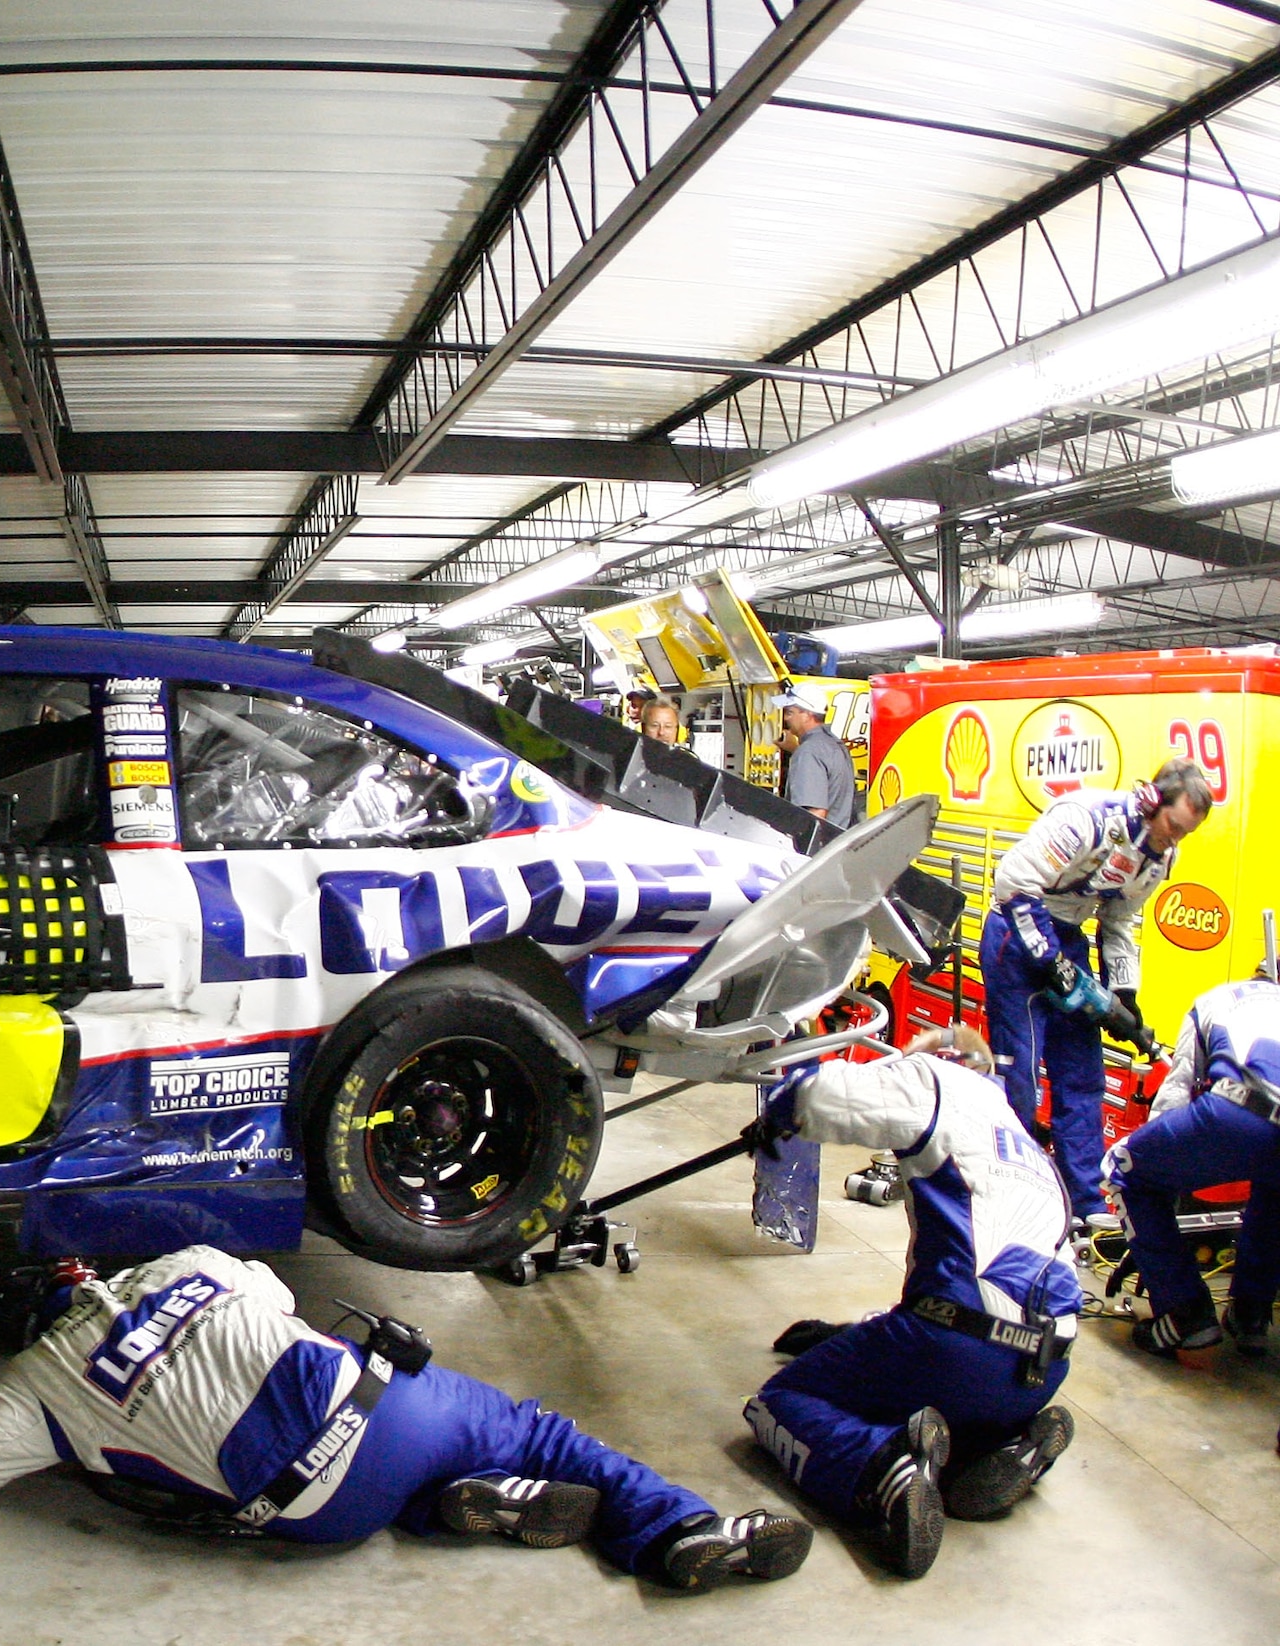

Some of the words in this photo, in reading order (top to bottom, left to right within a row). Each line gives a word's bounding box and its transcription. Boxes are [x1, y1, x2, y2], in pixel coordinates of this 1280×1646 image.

[104, 676, 162, 695] Hendrick
[103, 713, 167, 732] GUARD
[104, 743, 168, 757] Purolator
[1026, 737, 1104, 777] PENNZOIL
[129, 763, 165, 772] BOSCH
[130, 774, 167, 783] BOSCH
[112, 802, 173, 814] SIEMENS
[1157, 888, 1223, 935] Reese's
[150, 1074, 201, 1097] TOP
[205, 1066, 290, 1094] CHOICE
[150, 1095, 209, 1111] LUMBER
[216, 1089, 289, 1107] PRODUCTS
[96, 1279, 216, 1385] LOWE'S
[138, 1365, 164, 1396] Build
[163, 1314, 211, 1368] Something
[292, 1403, 365, 1480] LOWE'S
